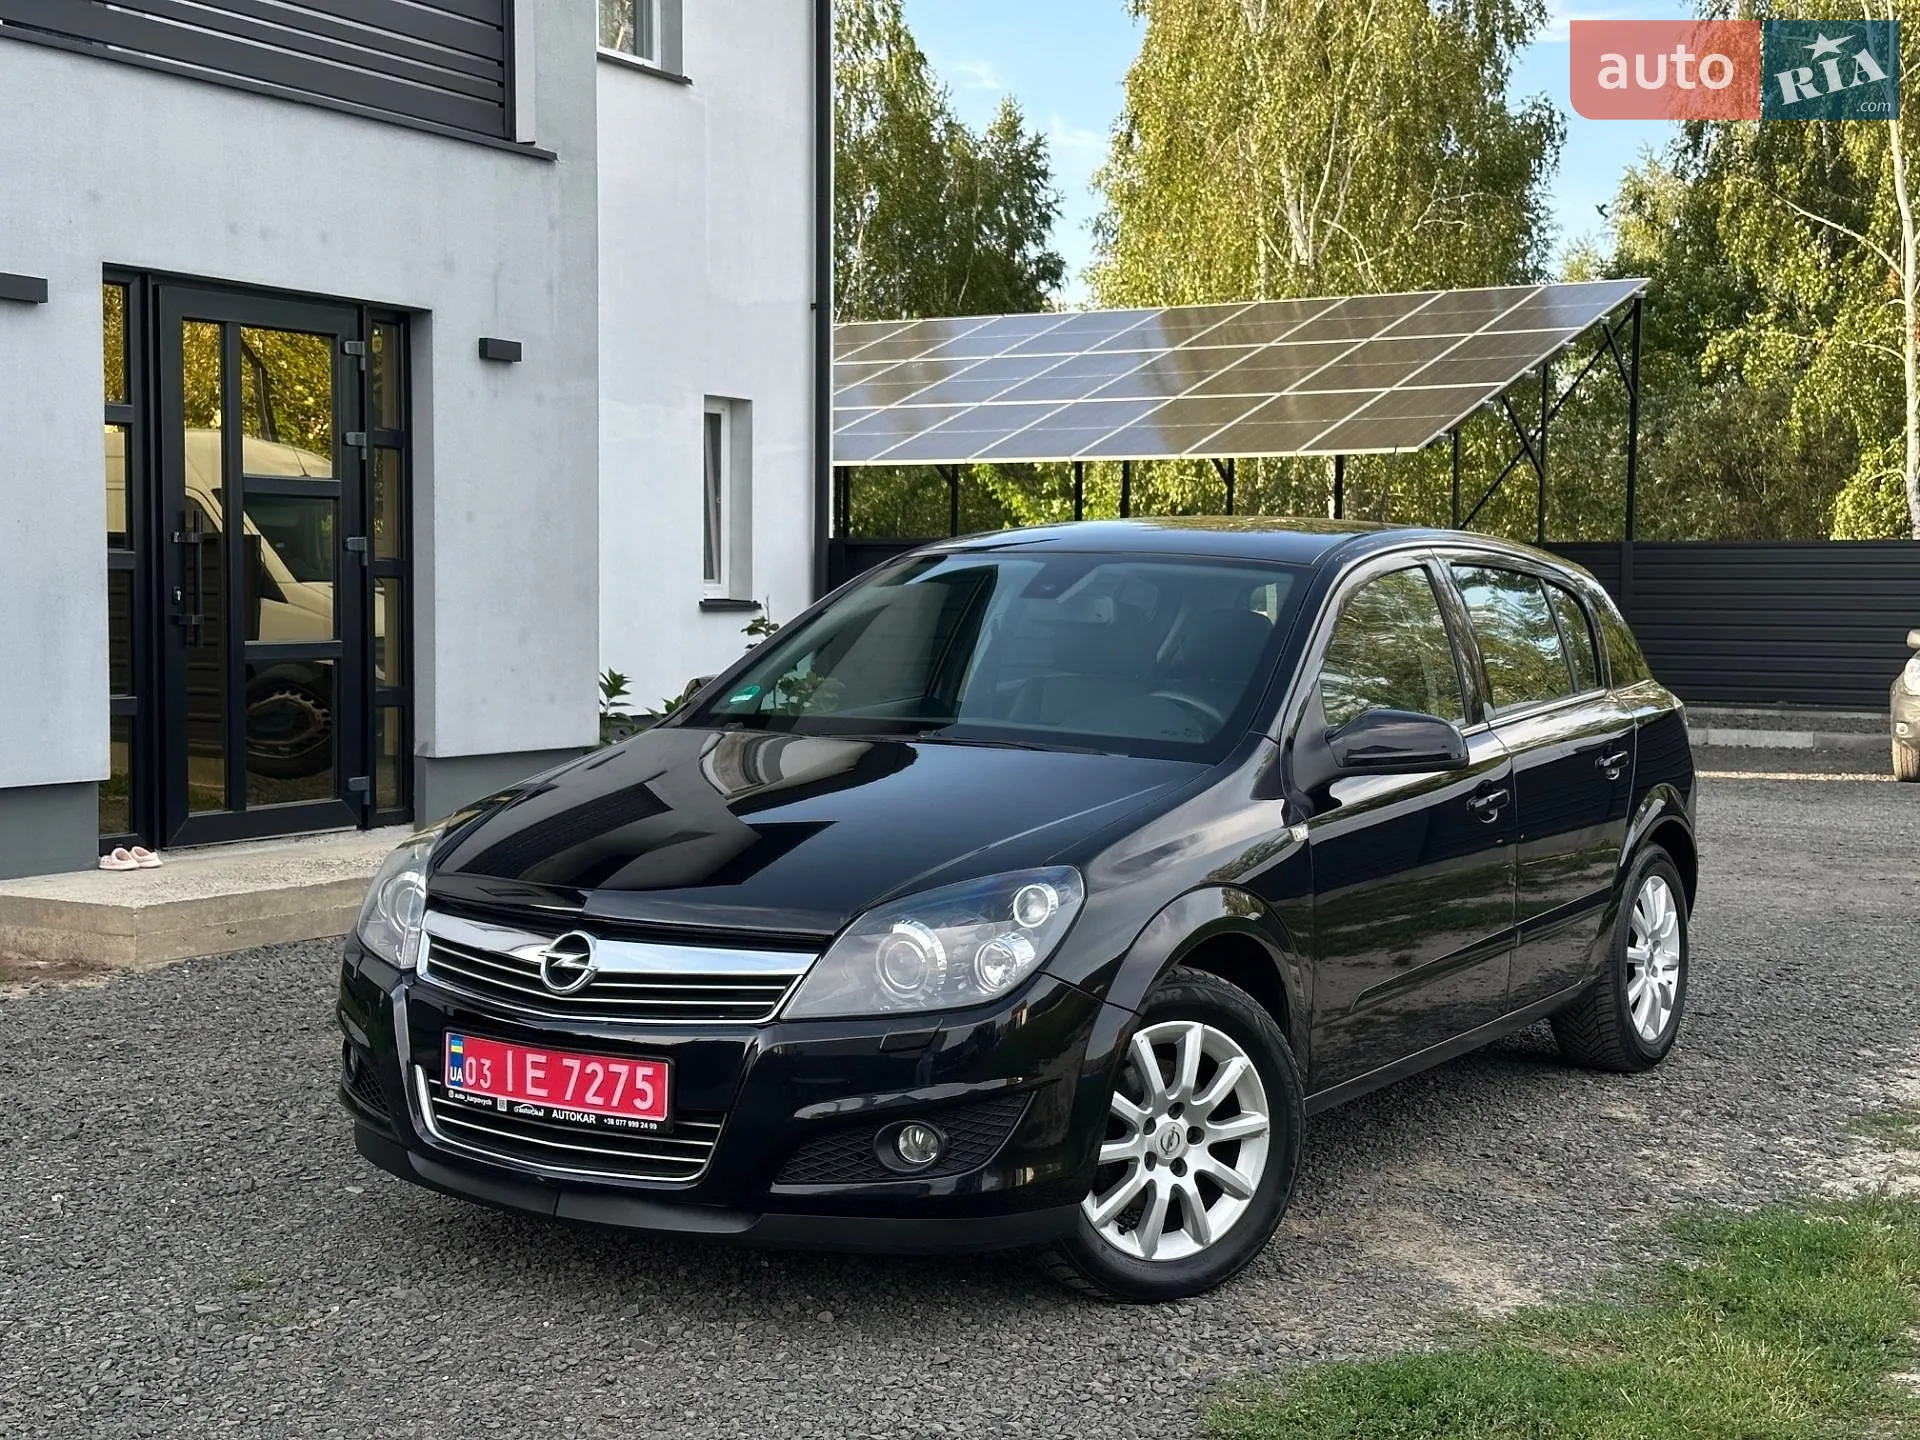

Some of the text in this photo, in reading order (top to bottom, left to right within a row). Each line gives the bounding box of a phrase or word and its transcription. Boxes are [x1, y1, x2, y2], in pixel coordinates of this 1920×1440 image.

[450, 1066, 463, 1083] UA
[465, 1050, 654, 1111] 03 IE 7275
[551, 1109, 596, 1125] AUTOKAR
